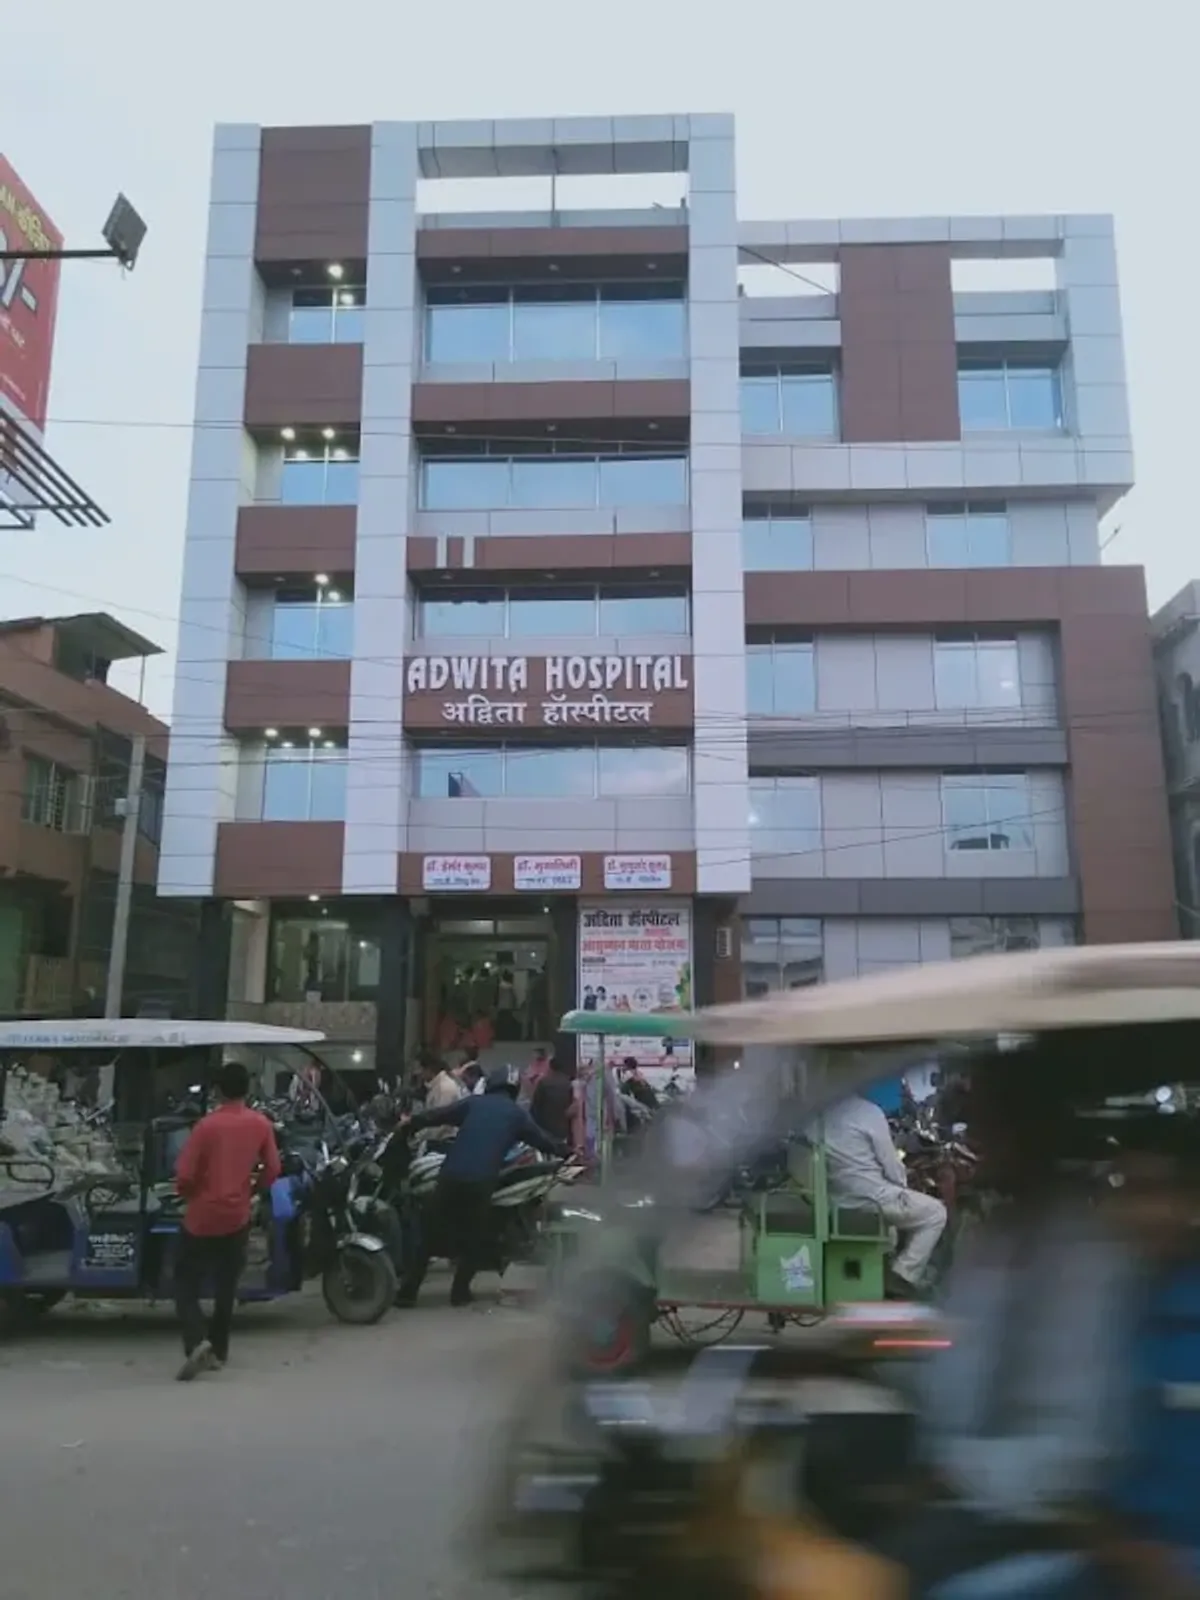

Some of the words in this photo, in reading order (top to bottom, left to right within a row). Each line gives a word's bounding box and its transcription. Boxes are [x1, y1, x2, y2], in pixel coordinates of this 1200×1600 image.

[407, 656, 528, 693] ADWITA
[545, 655, 689, 692] HOSPITAL
[442, 694, 527, 724] अद्विता
[541, 694, 653, 726] हॉस्पीटल
